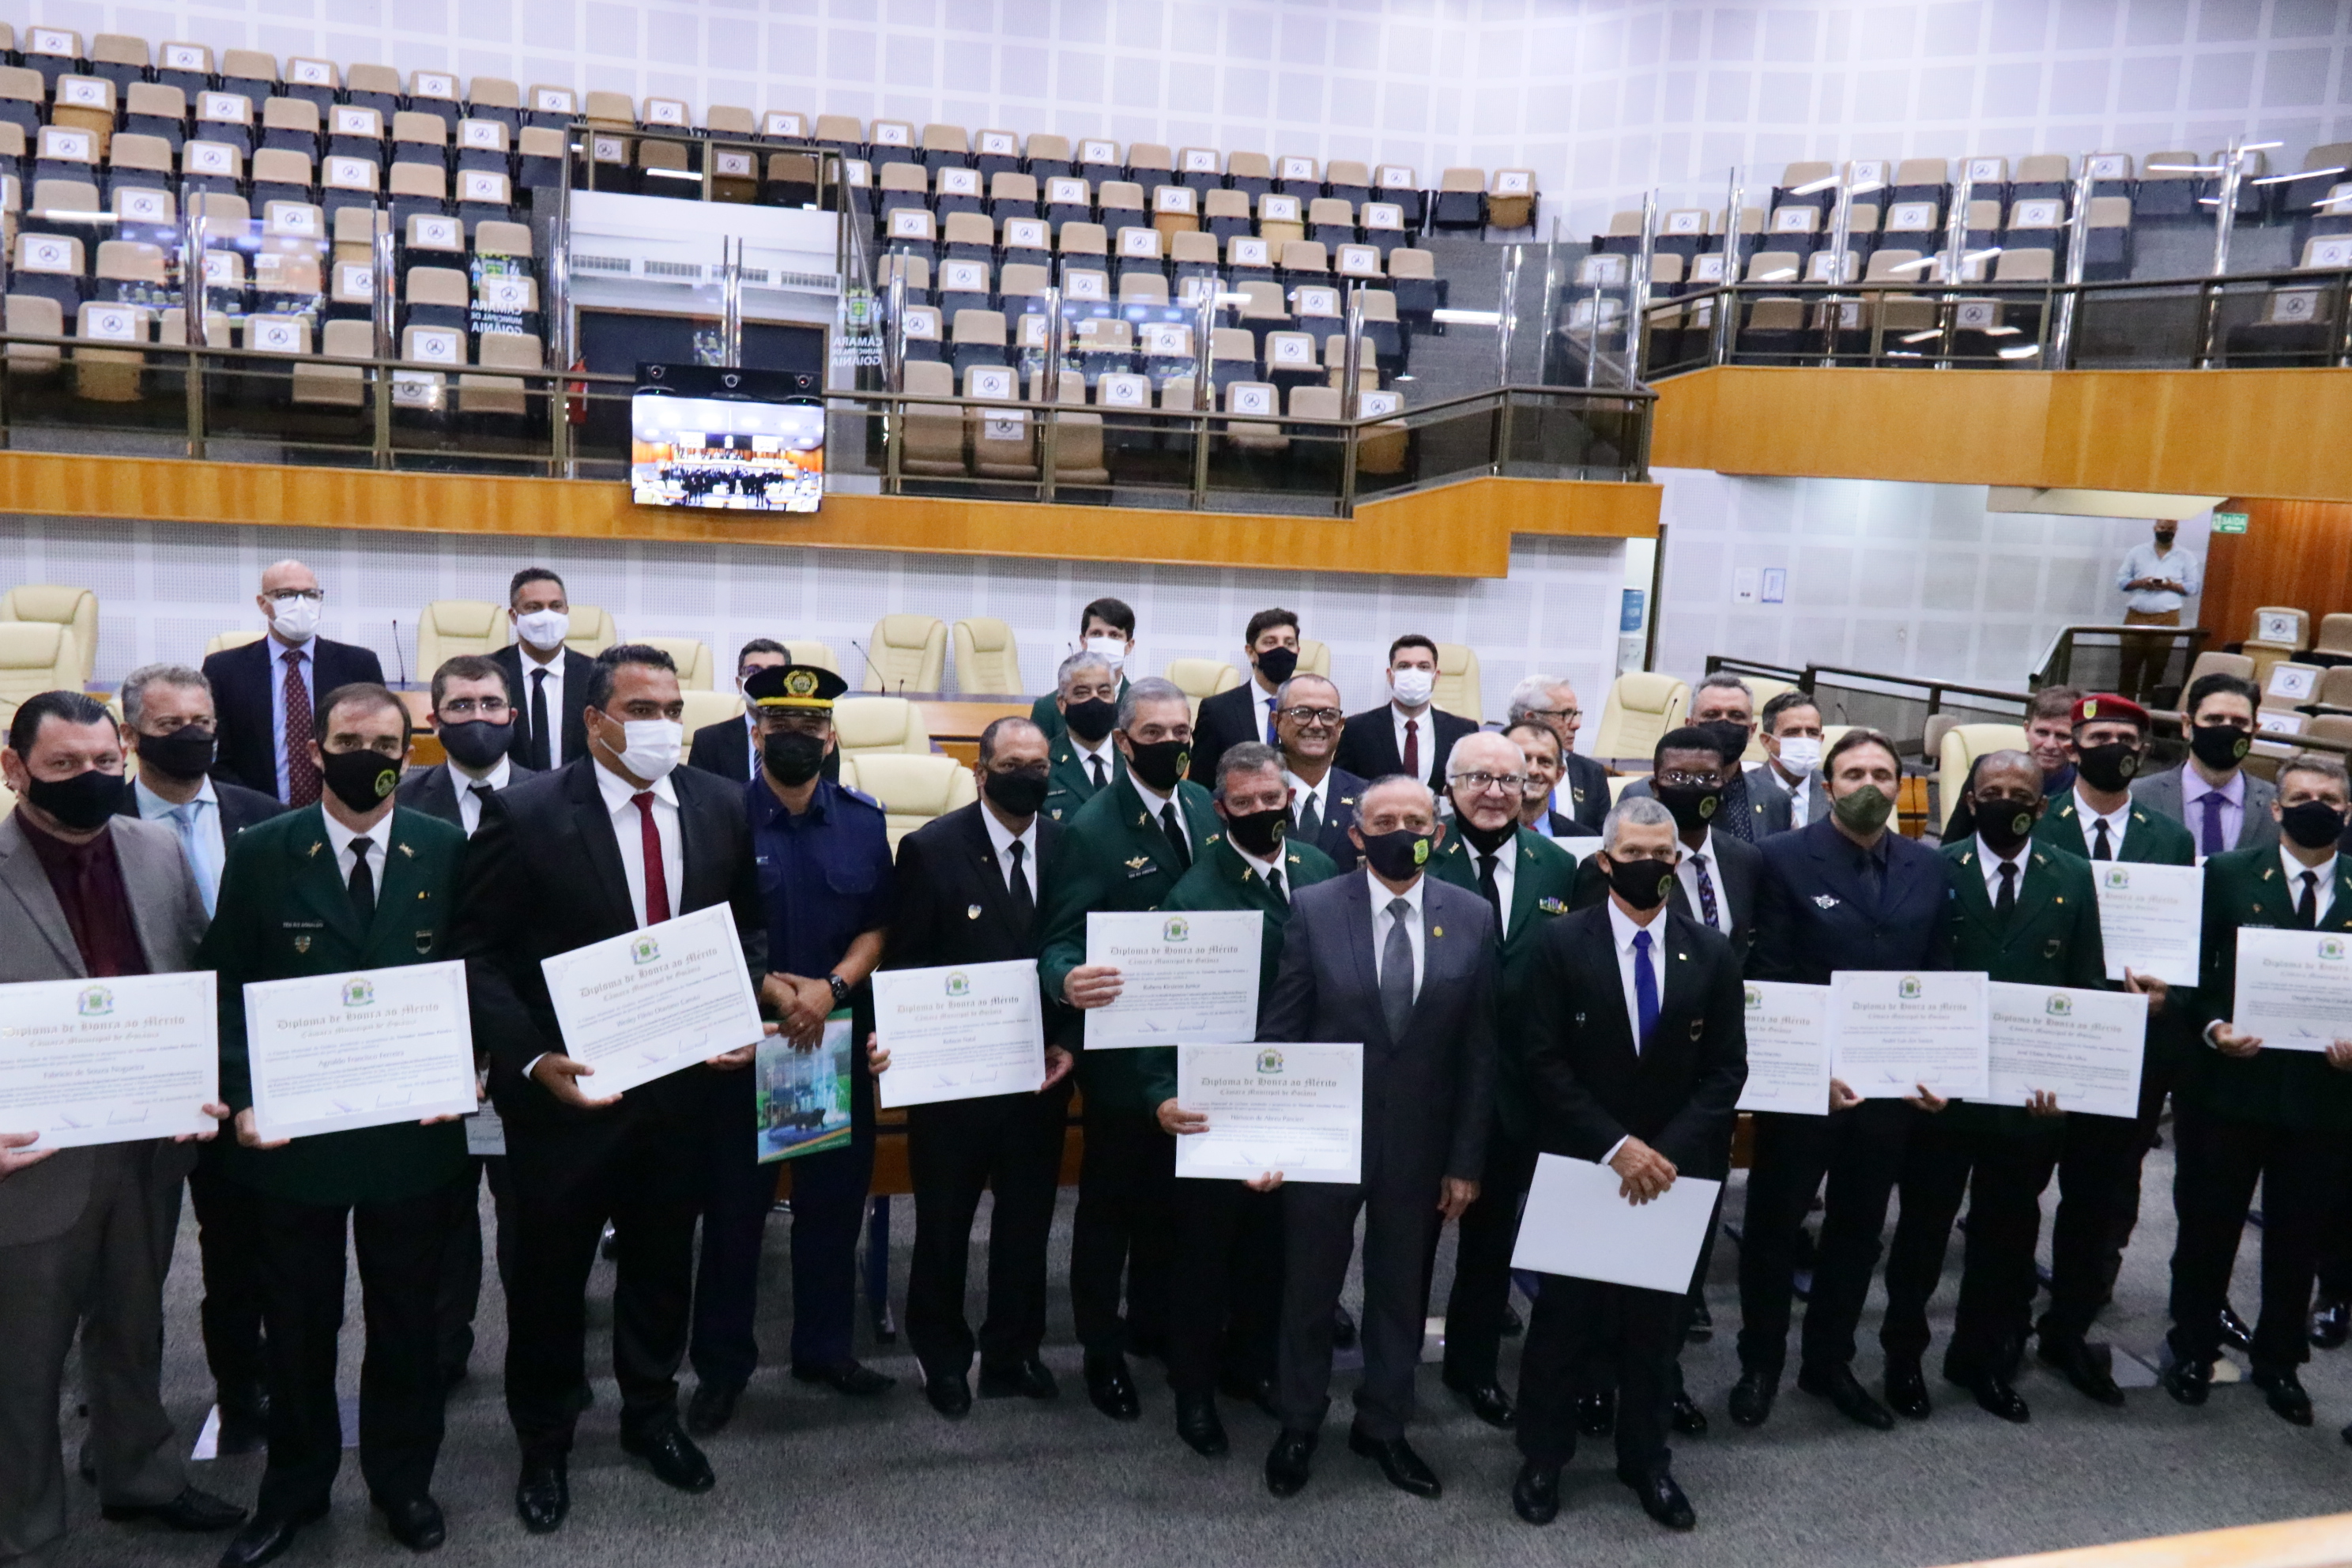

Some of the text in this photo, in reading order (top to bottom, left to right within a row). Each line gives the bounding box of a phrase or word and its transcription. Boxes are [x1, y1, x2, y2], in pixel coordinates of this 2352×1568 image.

[1110, 947, 1148, 956] Diploma
[1165, 945, 1193, 954] Honra
[1208, 944, 1238, 954] Mérito
[579, 948, 718, 998] Diploma de Honra ao Mérito
[897, 1004, 933, 1015] Diploma
[948, 1000, 975, 1009] Honra
[990, 995, 1019, 1006] Mérito
[1852, 1002, 1886, 1011] Diploma
[1900, 1001, 1925, 1011] Honra
[1939, 1001, 1967, 1011] Mérito
[62, 1023, 75, 1034] de
[80, 1020, 120, 1032] Honra
[124, 1020, 139, 1029] ao
[143, 1016, 185, 1028] Mérito
[277, 1004, 439, 1030] Diploma de Honra ao Mérito
[1201, 1077, 1241, 1087] Diploma
[1257, 1077, 1287, 1087] Honra
[1304, 1076, 1337, 1087] Mérito
